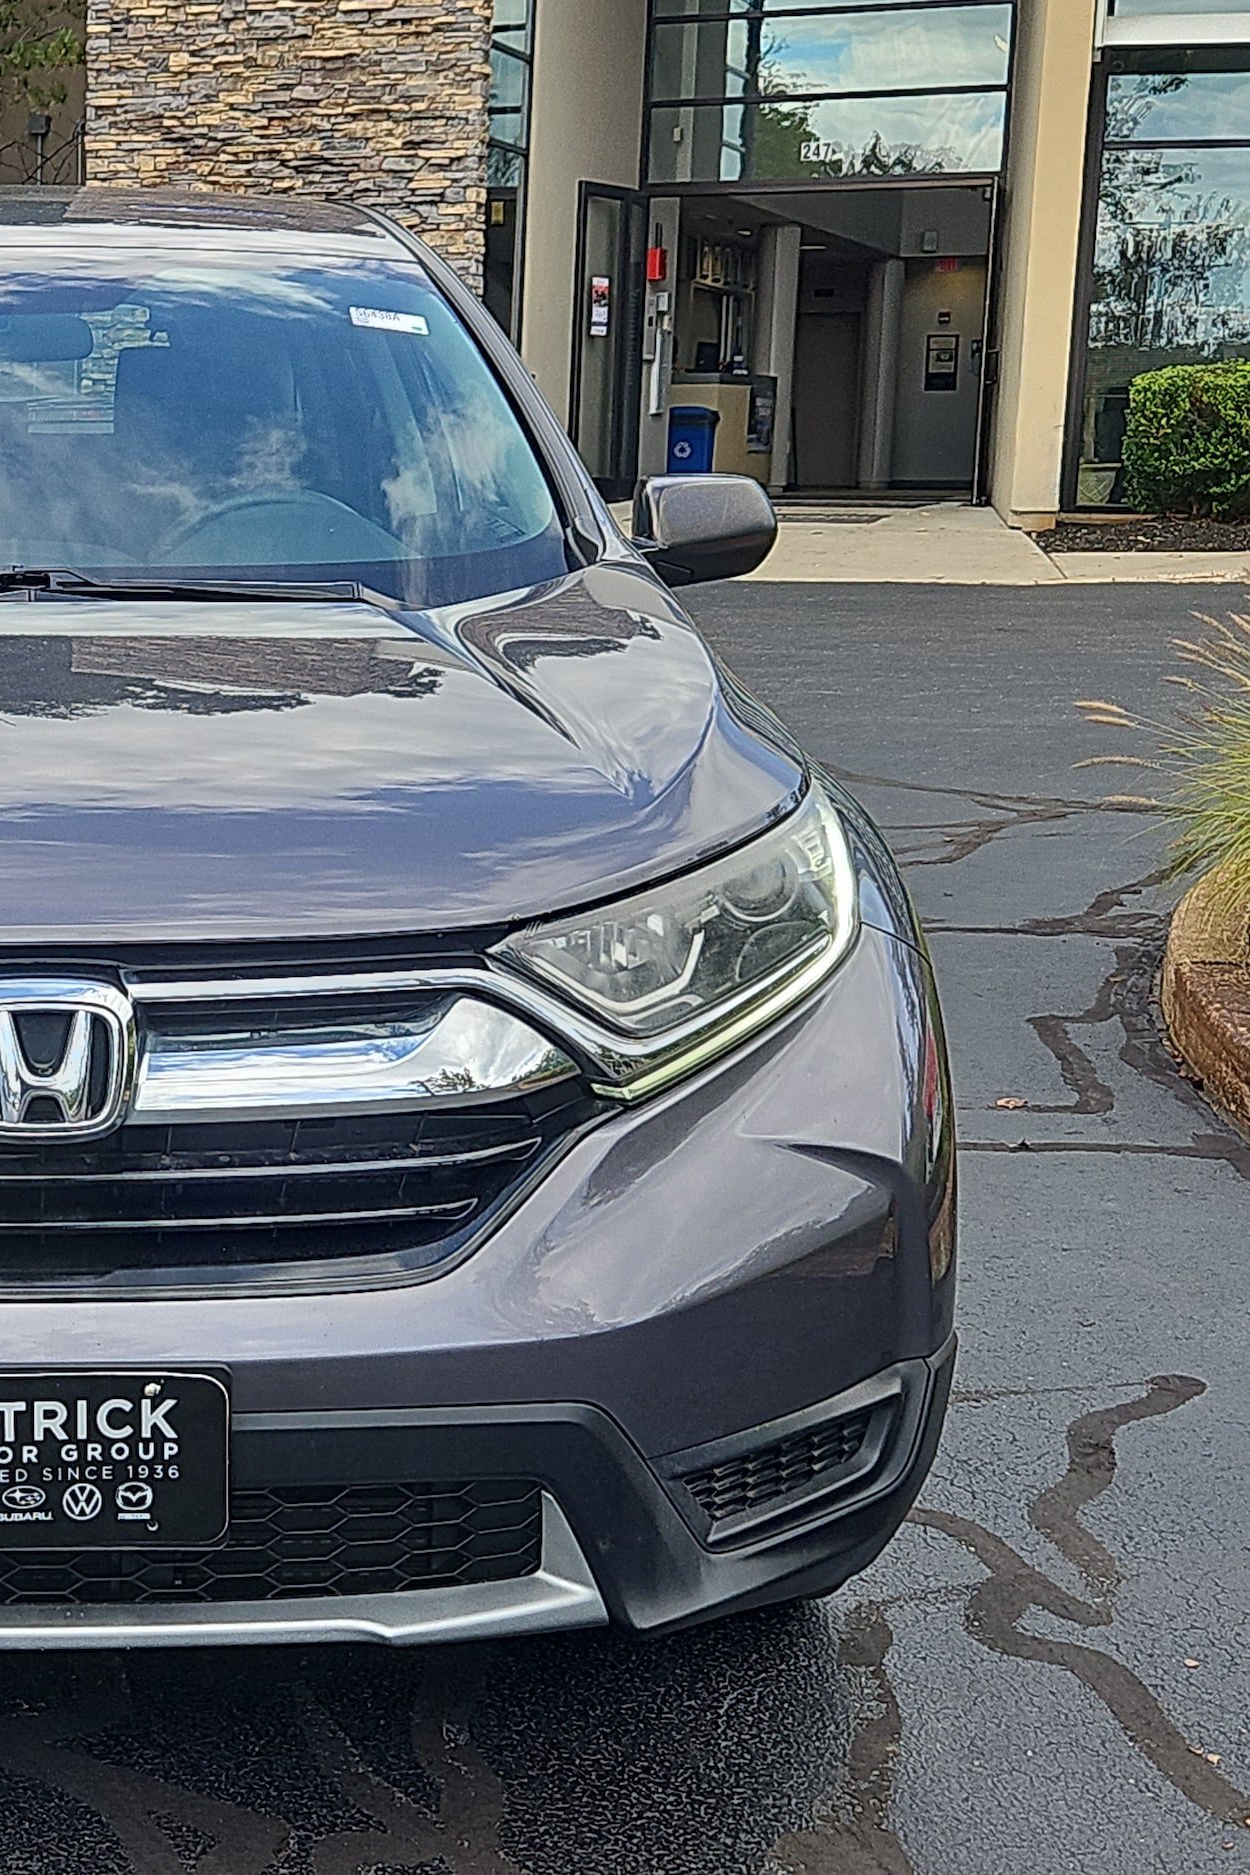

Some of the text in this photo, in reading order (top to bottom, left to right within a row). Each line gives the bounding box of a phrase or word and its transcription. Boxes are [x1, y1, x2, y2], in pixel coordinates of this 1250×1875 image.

[803, 143, 831, 160] 247
[61, 1443, 179, 1462] GROUP
[42, 1466, 114, 1482] SINCE
[127, 1465, 180, 1480] 1936
